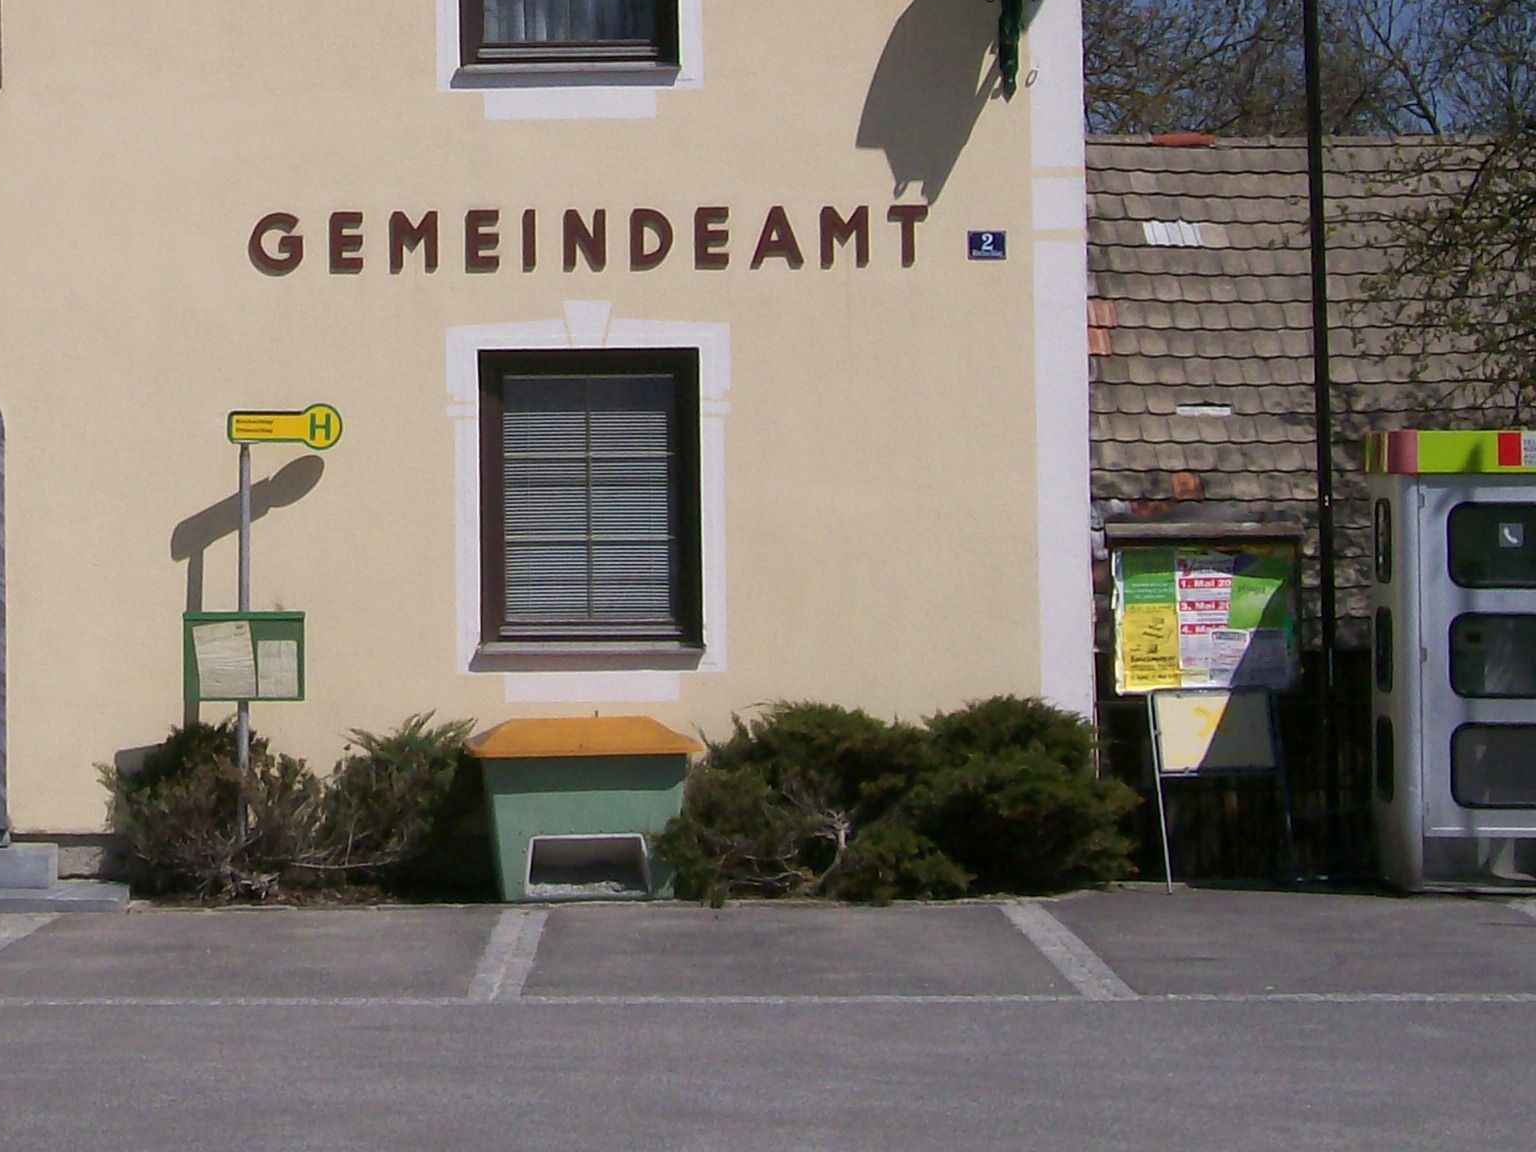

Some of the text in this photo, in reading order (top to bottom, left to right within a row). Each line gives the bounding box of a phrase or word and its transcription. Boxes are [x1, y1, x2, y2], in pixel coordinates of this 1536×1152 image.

[247, 205, 928, 277] GEMEINDEAMT
[981, 233, 994, 250] 2
[310, 413, 331, 440] H
[1194, 579, 1215, 588] Mai
[1195, 601, 1216, 609] Mai
